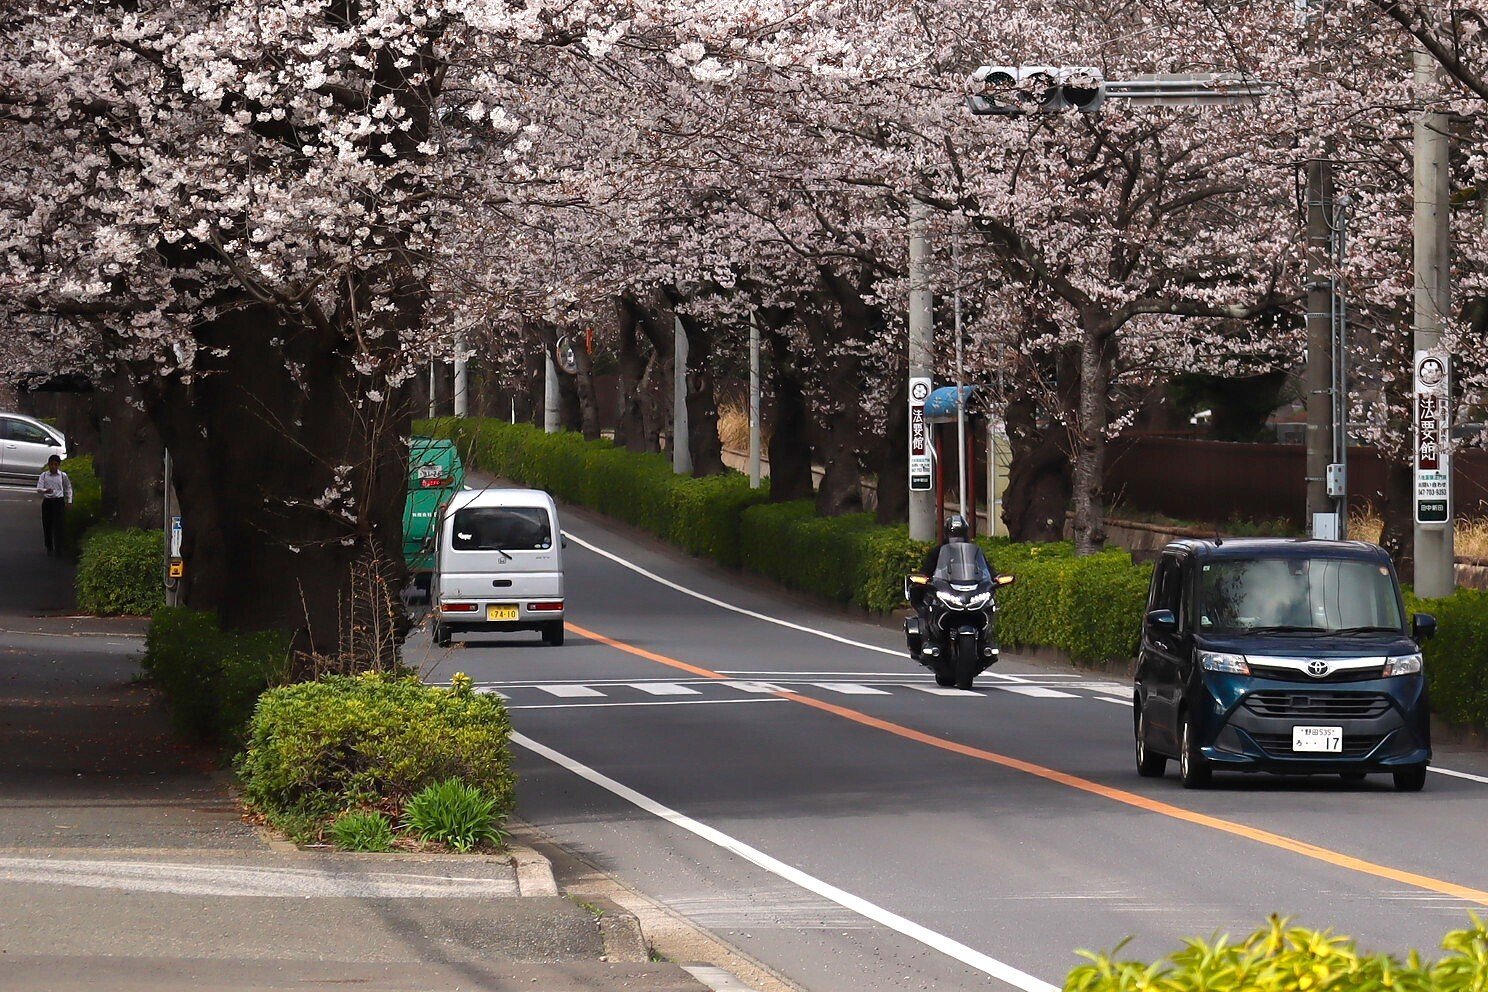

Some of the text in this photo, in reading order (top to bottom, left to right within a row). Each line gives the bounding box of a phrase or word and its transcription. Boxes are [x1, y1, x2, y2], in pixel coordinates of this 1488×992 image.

[912, 409, 925, 450] 法要館
[1420, 399, 1436, 461] 法要館
